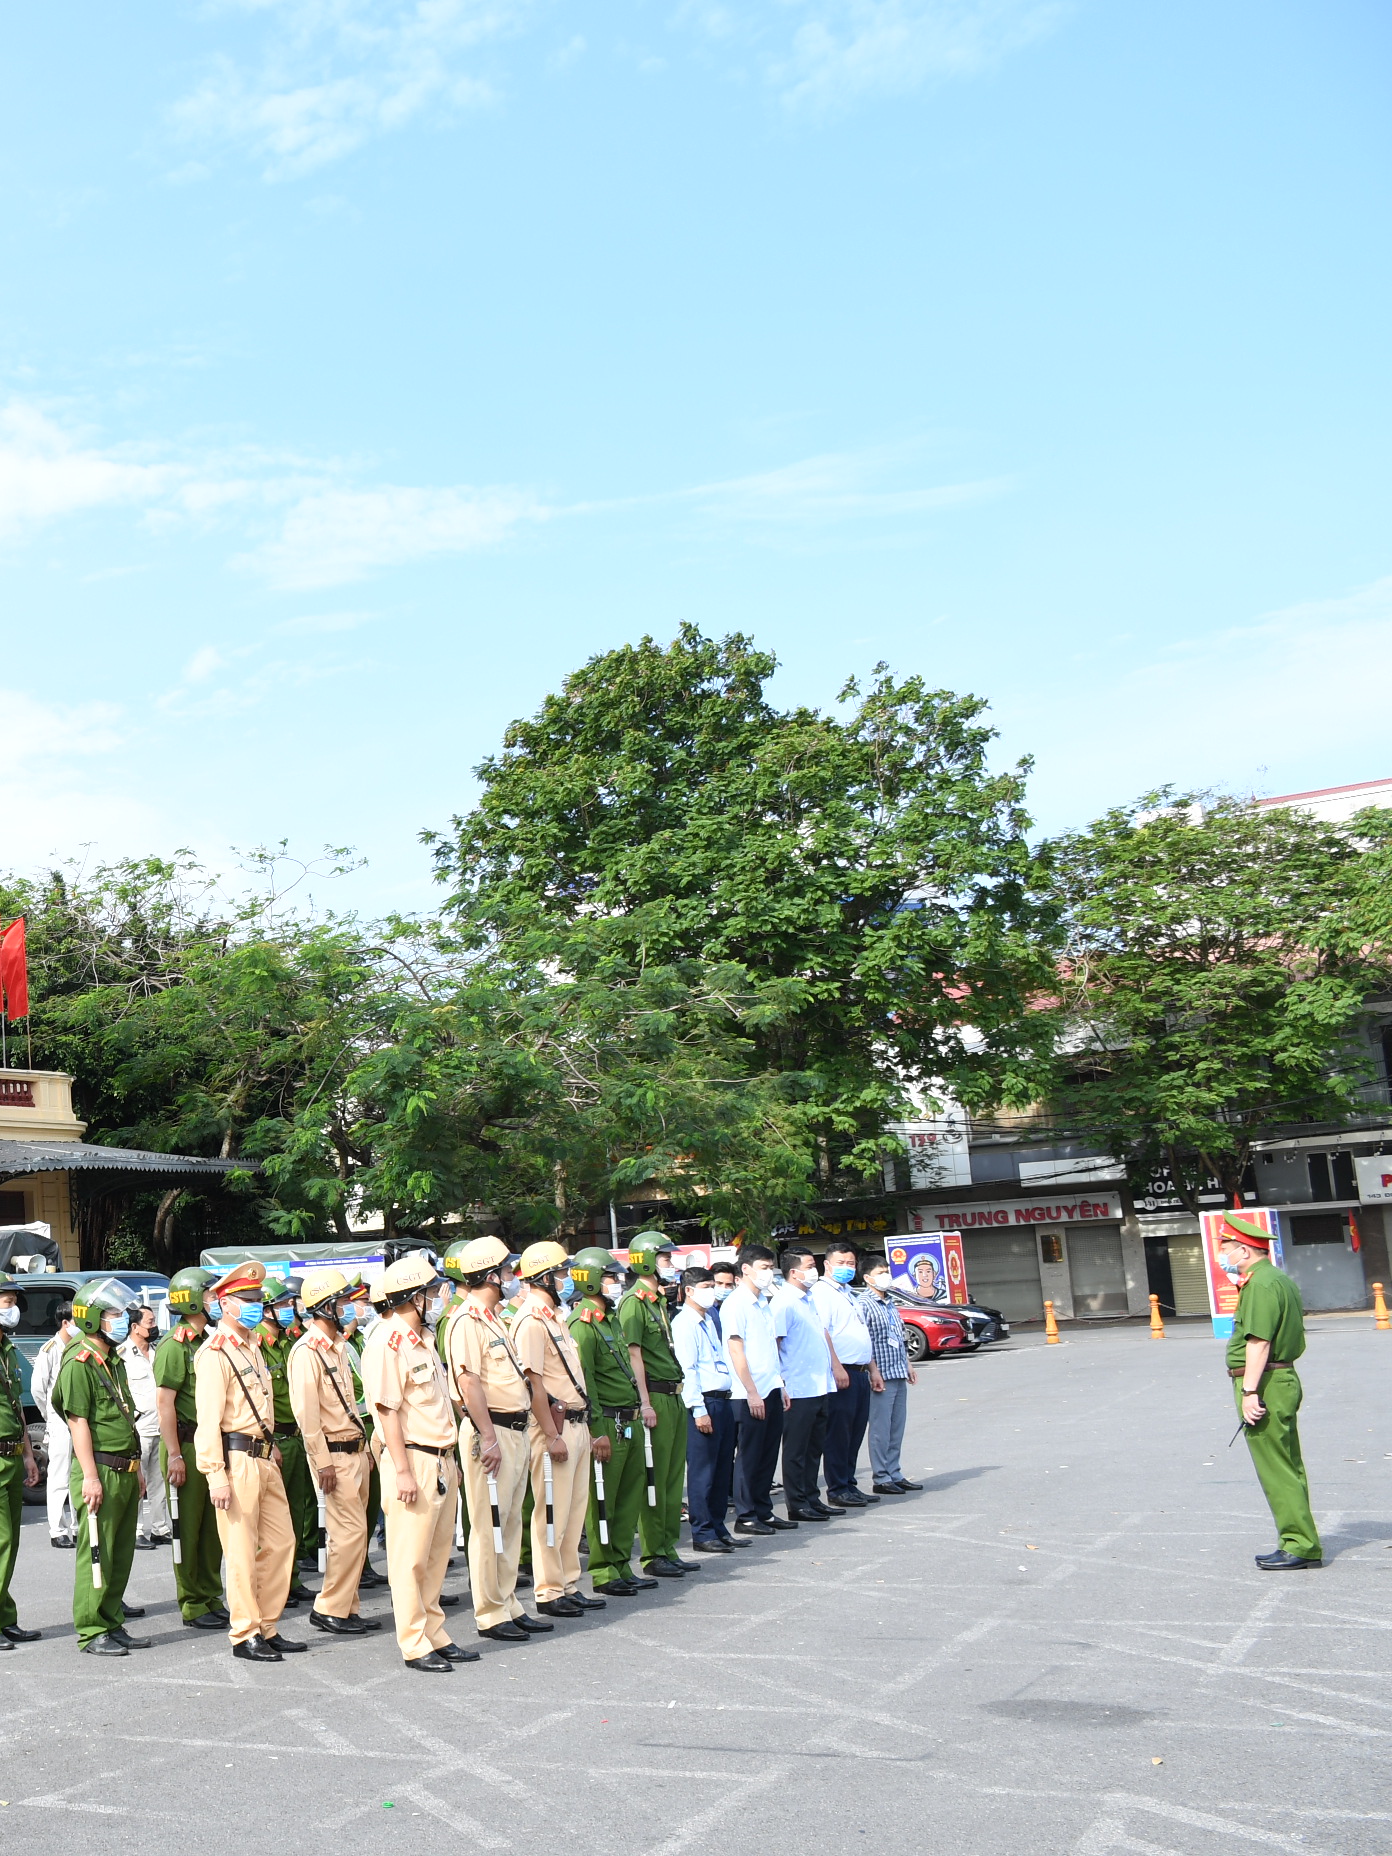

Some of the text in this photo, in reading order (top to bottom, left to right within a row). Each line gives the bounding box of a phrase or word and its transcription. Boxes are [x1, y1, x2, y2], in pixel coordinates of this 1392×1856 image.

[909, 1133, 937, 1148] 139
[935, 1200, 1110, 1230] TRUNG NGUYÊN
[470, 1255, 496, 1269] CSGT
[528, 1254, 550, 1268] CSGT
[396, 1272, 422, 1286] CSGT
[309, 1280, 330, 1297] CSGT
